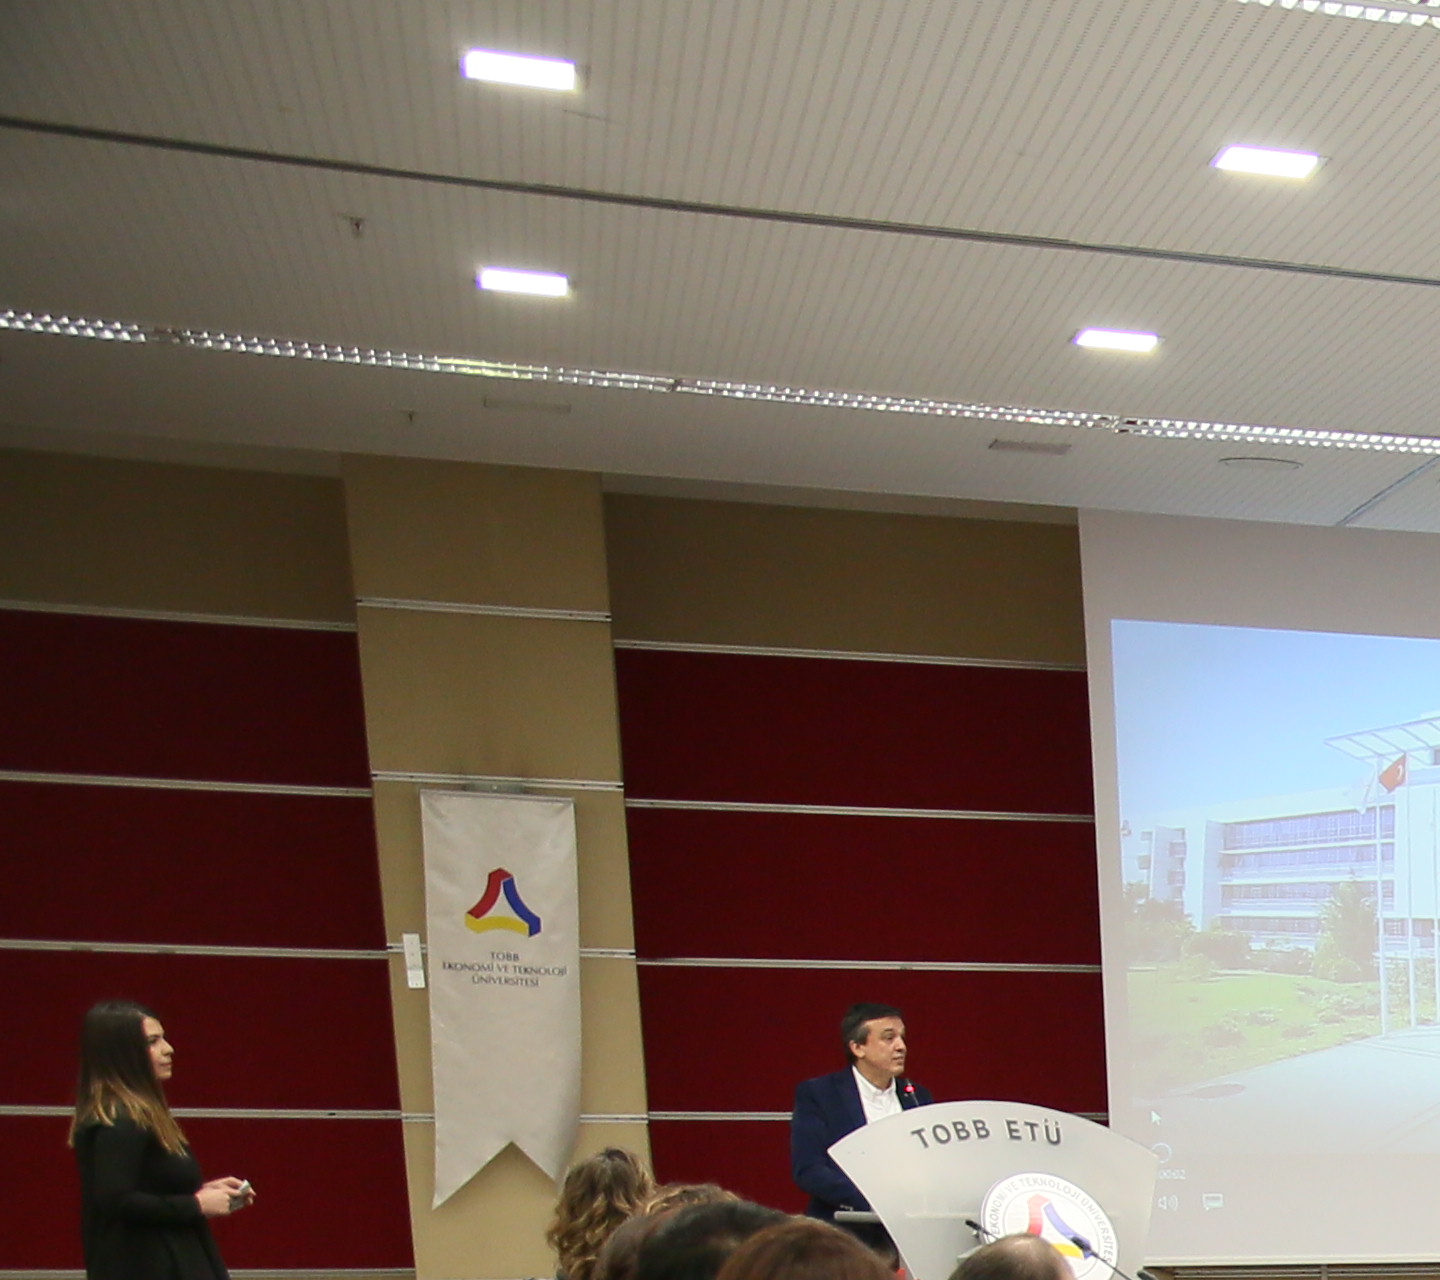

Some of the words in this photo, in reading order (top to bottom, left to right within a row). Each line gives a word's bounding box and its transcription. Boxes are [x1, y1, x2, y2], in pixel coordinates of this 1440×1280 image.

[490, 951, 520, 962] TOBB
[442, 961, 494, 973] EKONOMİ
[496, 963, 508, 974] VE
[513, 964, 567, 977] TEKNOLOJİ
[471, 973, 540, 987] ÜNİVERSİTESİ
[911, 1119, 990, 1148] TOBB
[1004, 1117, 1062, 1146] ETÜ
[1080, 1196, 1114, 1264] ÜNİVERSİTES
